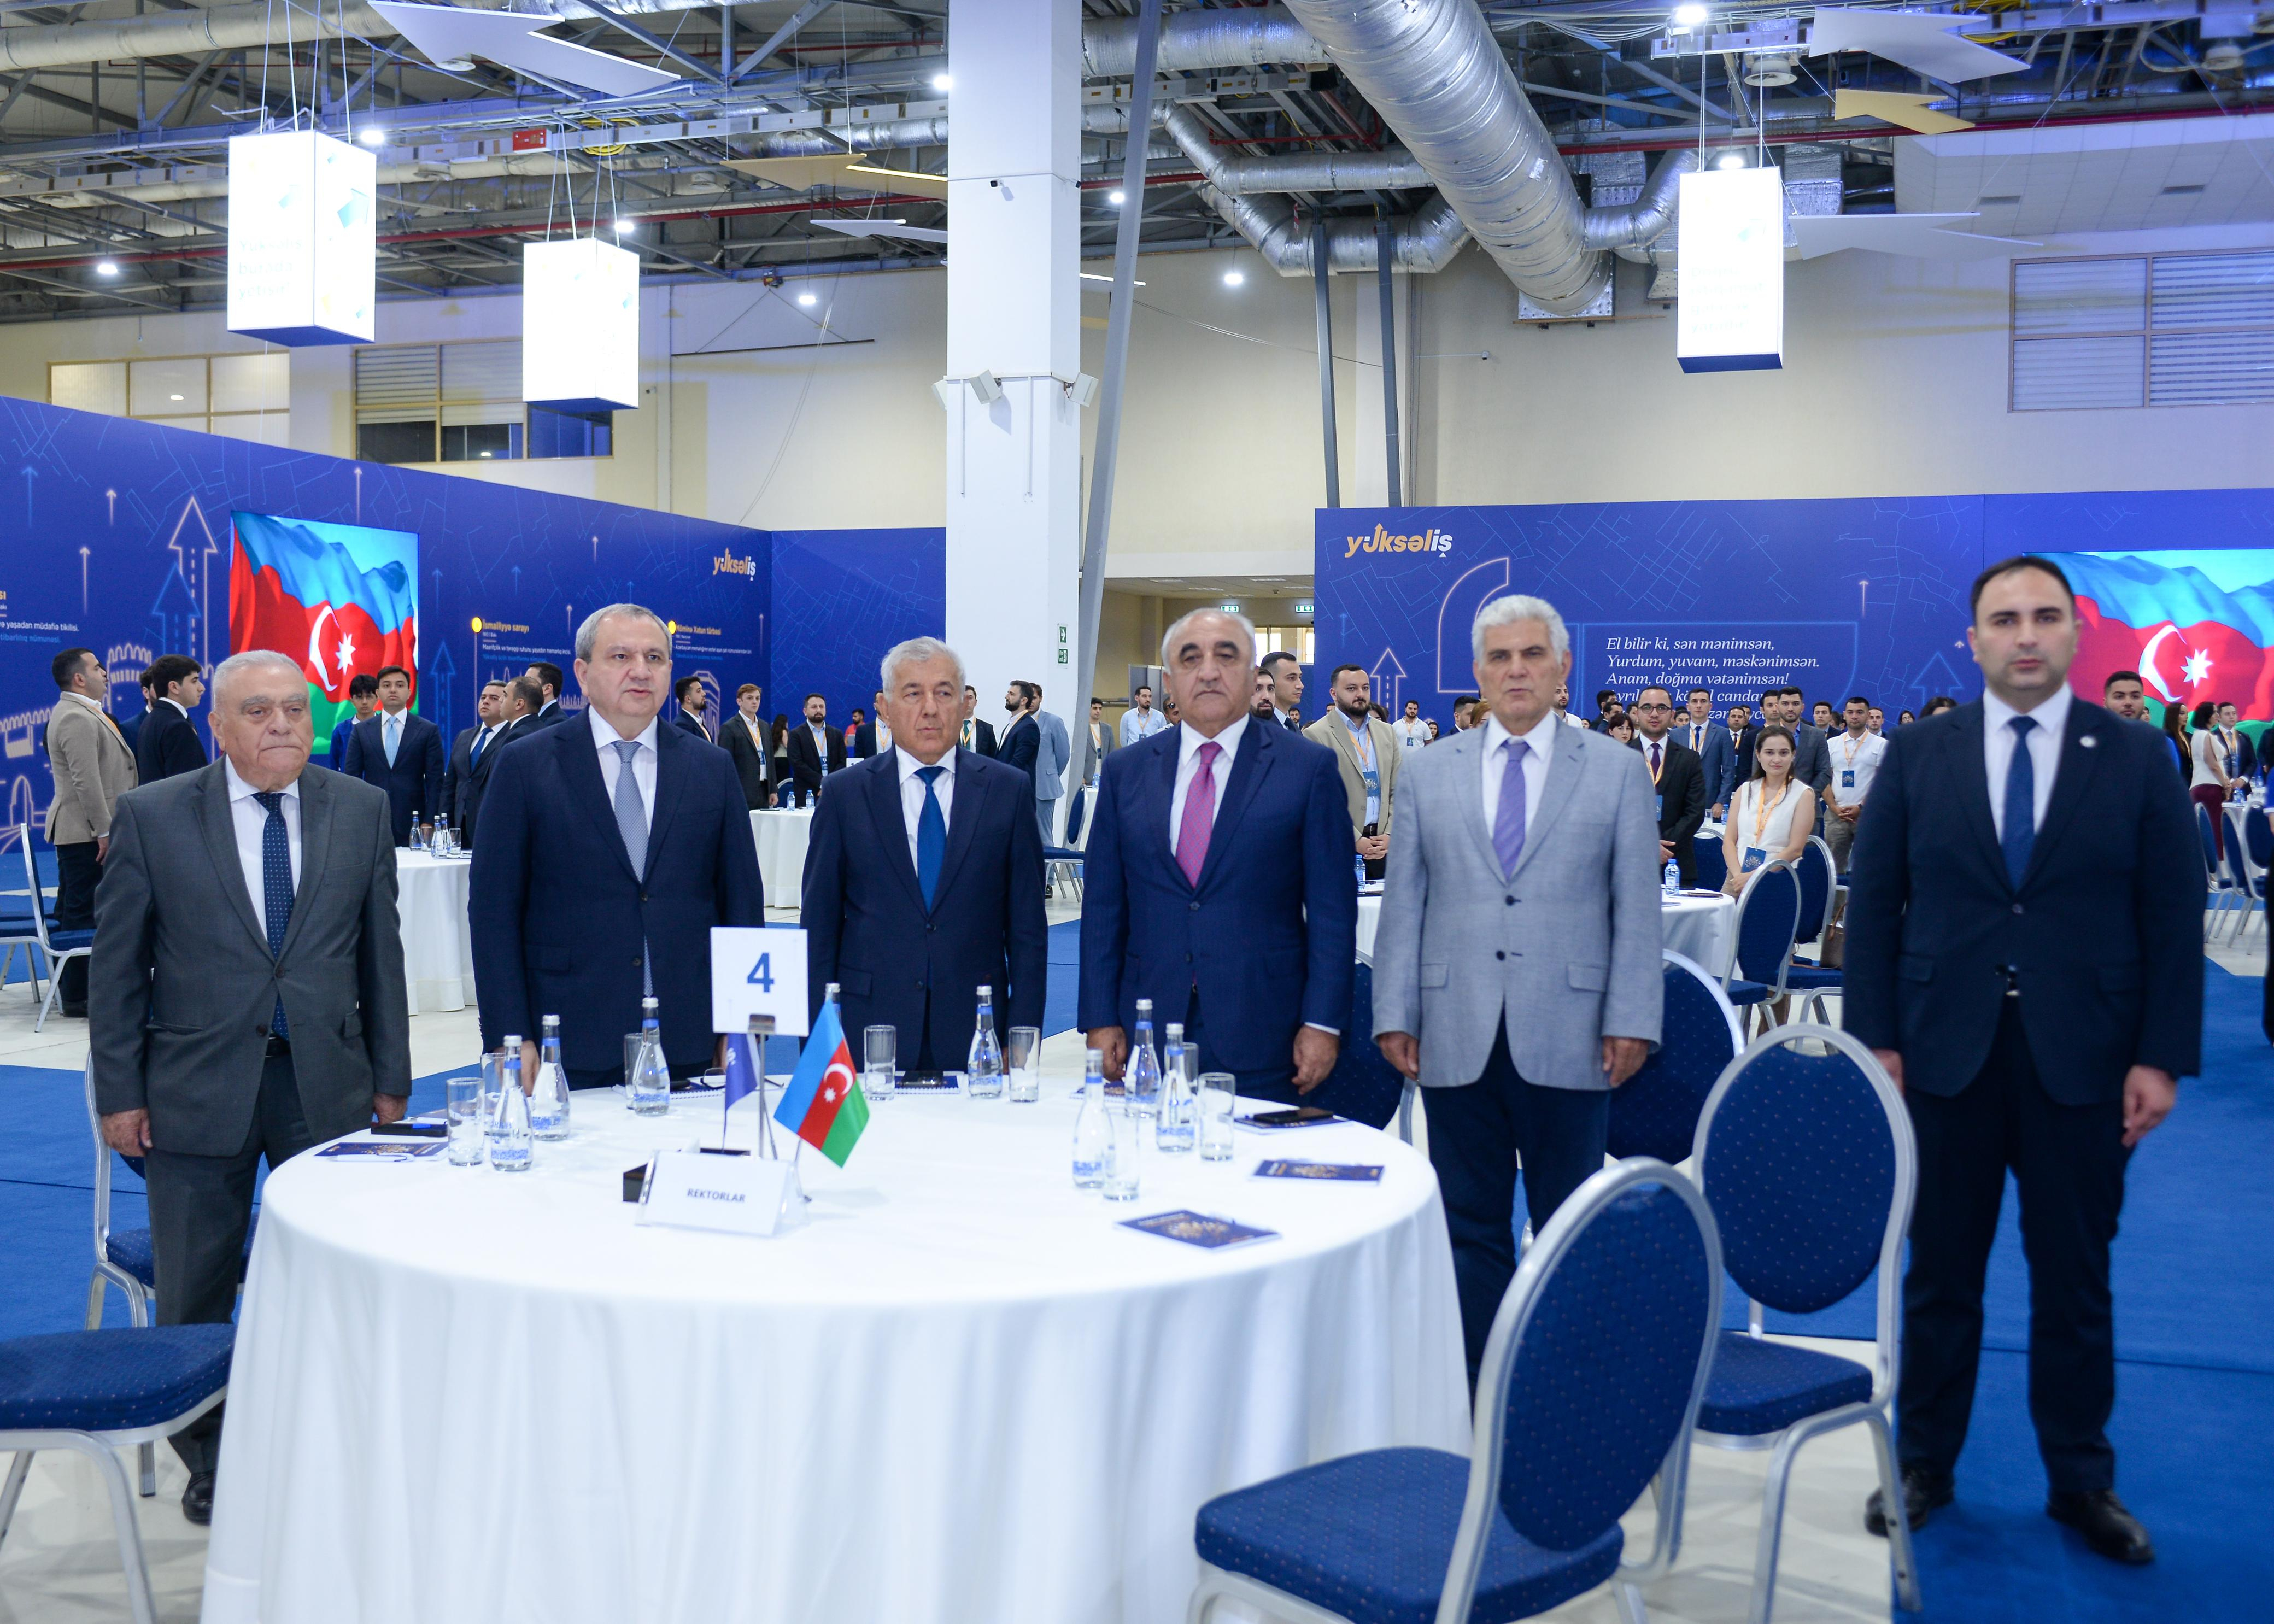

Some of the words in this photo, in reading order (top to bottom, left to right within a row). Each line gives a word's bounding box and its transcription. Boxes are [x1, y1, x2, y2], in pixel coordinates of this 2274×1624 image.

[1344, 523, 1452, 558] yüksəliş
[712, 548, 756, 581] yüksəliş
[1606, 637, 1621, 650] El
[1624, 637, 1651, 650] bilir
[1655, 637, 1669, 650] ki,
[1673, 640, 1696, 649] sən
[1701, 637, 1774, 651] mənimsən,
[1608, 654, 1665, 668] Yurdum,
[1668, 658, 1719, 670] yuvam,
[1723, 655, 1819, 667] məskənimsən.
[1605, 672, 1651, 685] Anam,
[1656, 672, 1702, 688] doğma
[1707, 673, 1789, 684] vətənimsən!
[747, 952, 775, 993] 4
[687, 1188, 746, 1202] REKTORLAR
